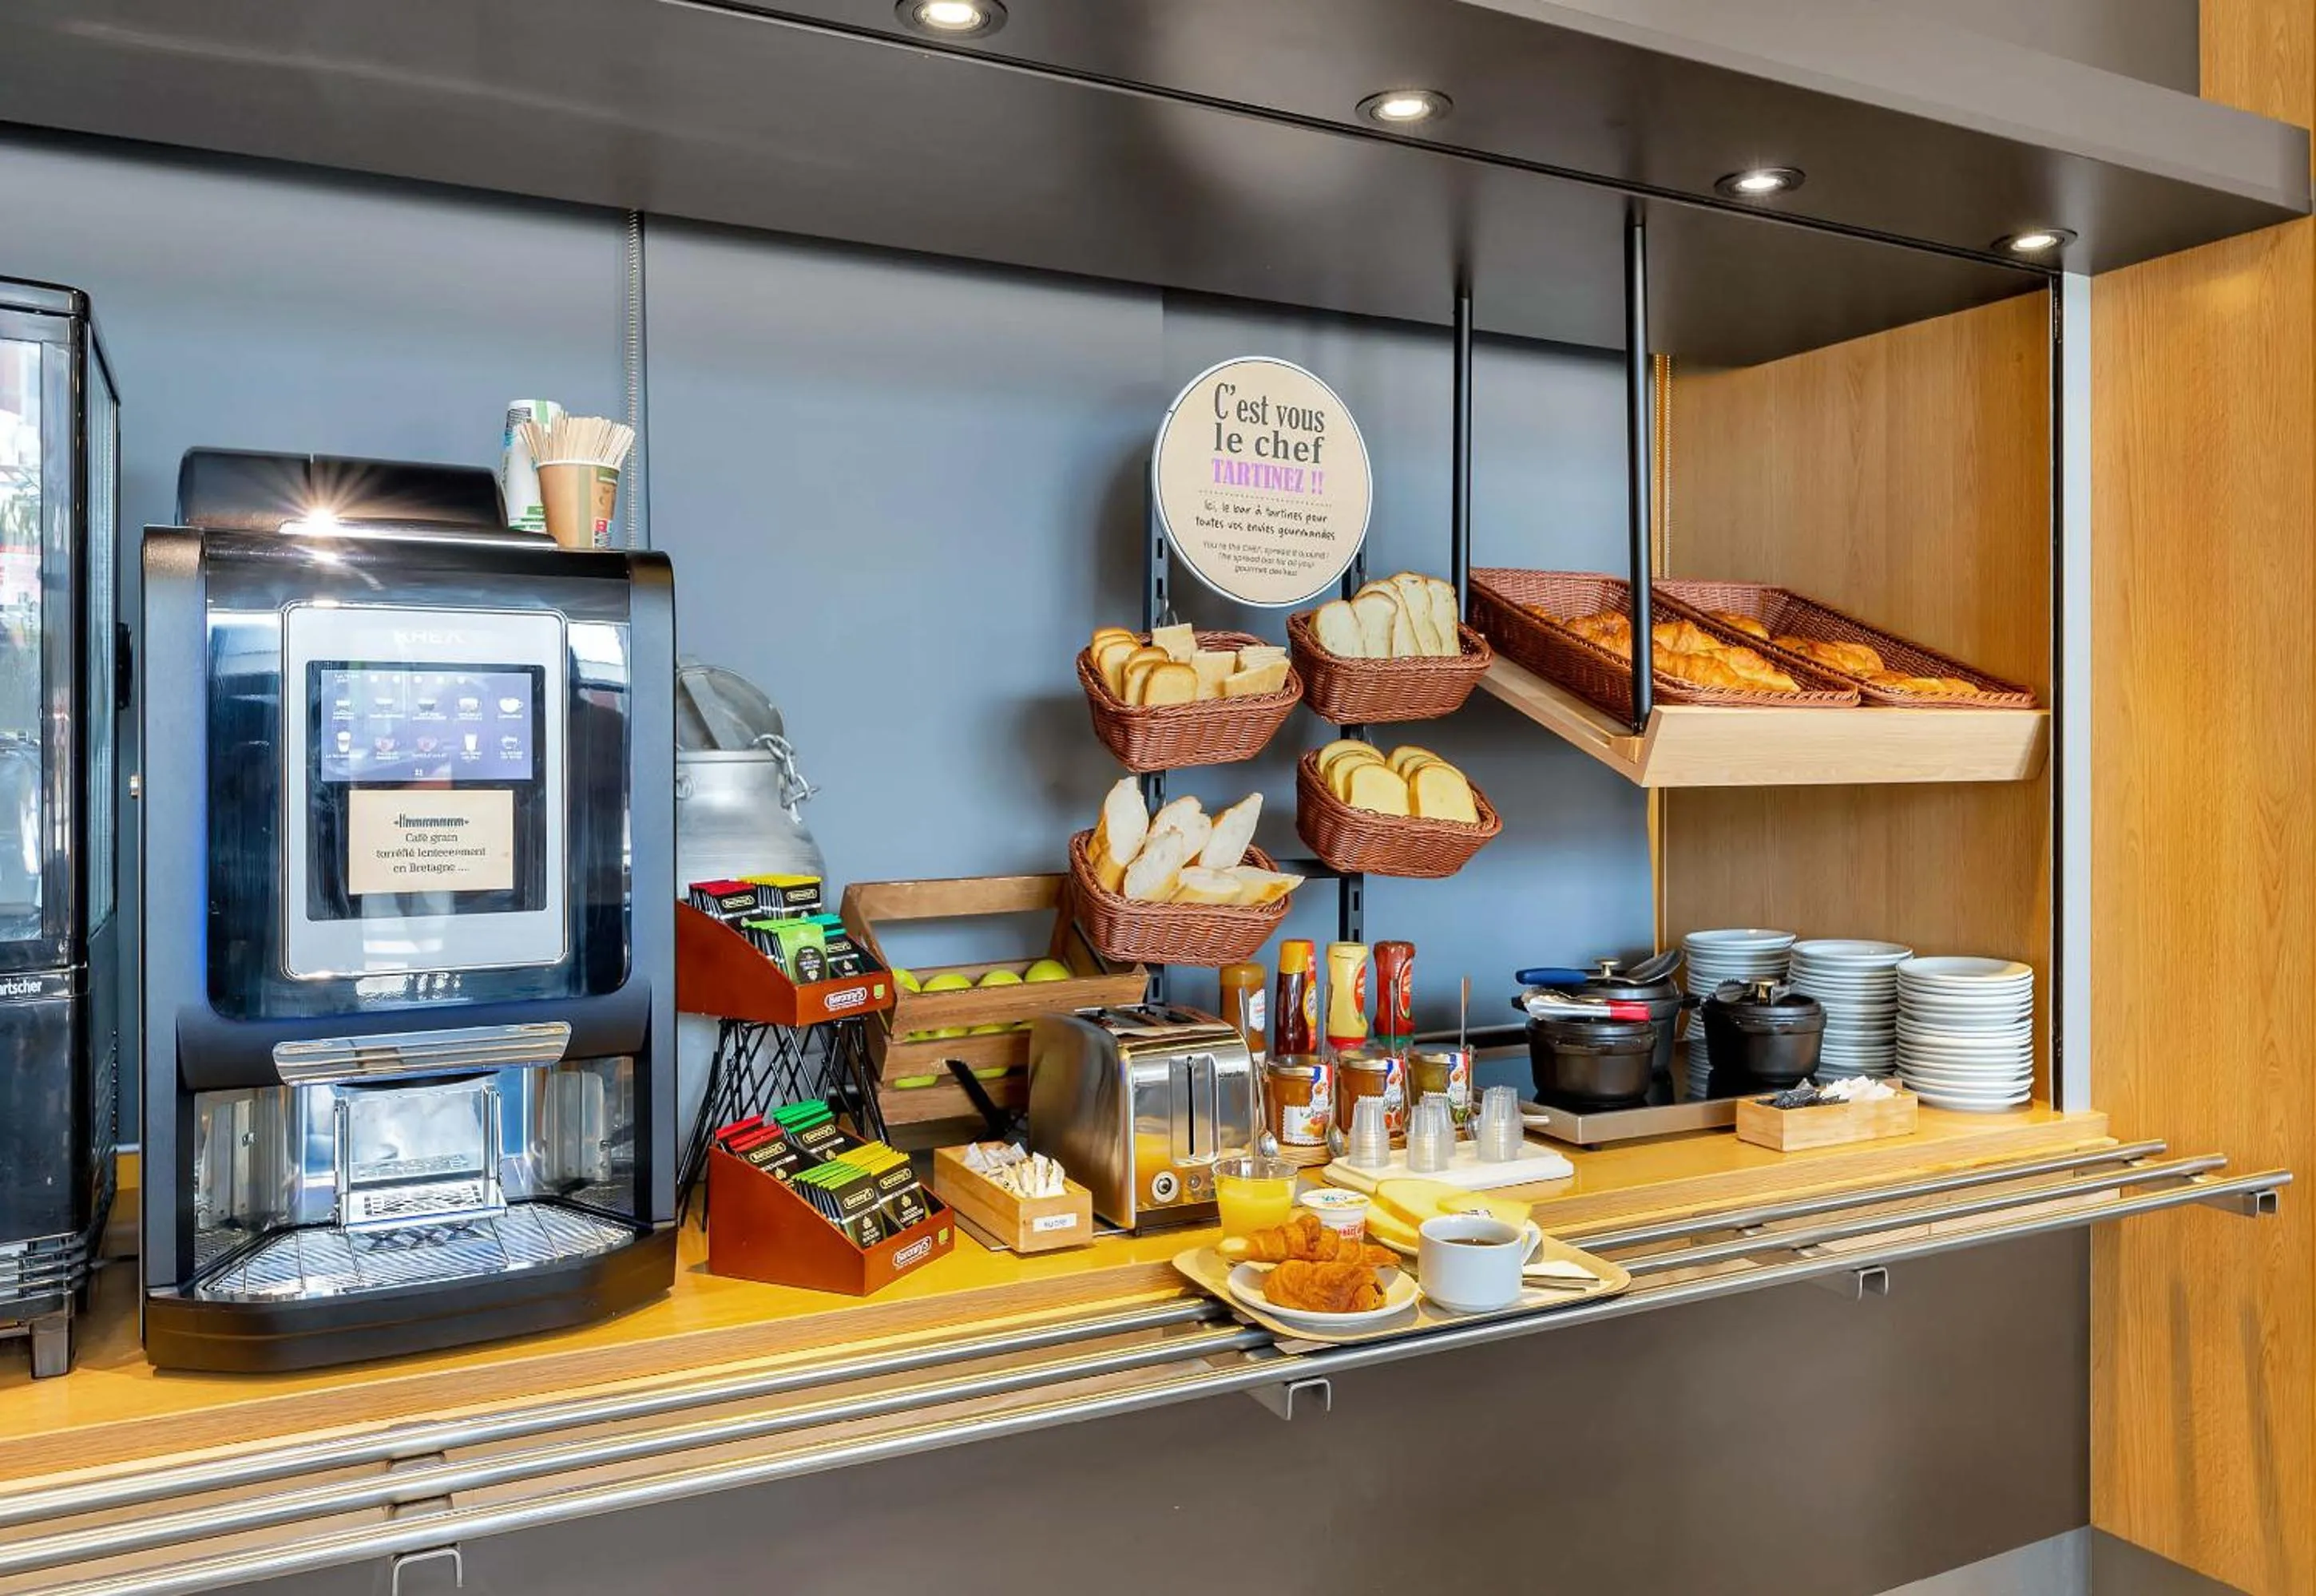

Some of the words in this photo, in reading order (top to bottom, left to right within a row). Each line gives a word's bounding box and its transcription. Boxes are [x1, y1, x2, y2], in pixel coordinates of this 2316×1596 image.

[1214, 382, 1269, 426] C'est
[1276, 405, 1325, 433] vous
[1215, 422, 1243, 453] le
[1255, 430, 1325, 464] chef
[1212, 457, 1304, 493] TARTINEZ
[1311, 469, 1324, 495] !!
[1223, 501, 1230, 513] le
[1234, 504, 1251, 513] bar
[1255, 504, 1262, 516] à
[1266, 507, 1303, 521] tartines
[1306, 513, 1327, 524] pour
[1228, 521, 1243, 531] vos
[1247, 522, 1275, 534] envies
[1279, 526, 1334, 541] gourmandes
[405, 833, 428, 842] Café
[430, 834, 458, 844] grain
[393, 864, 406, 873] en
